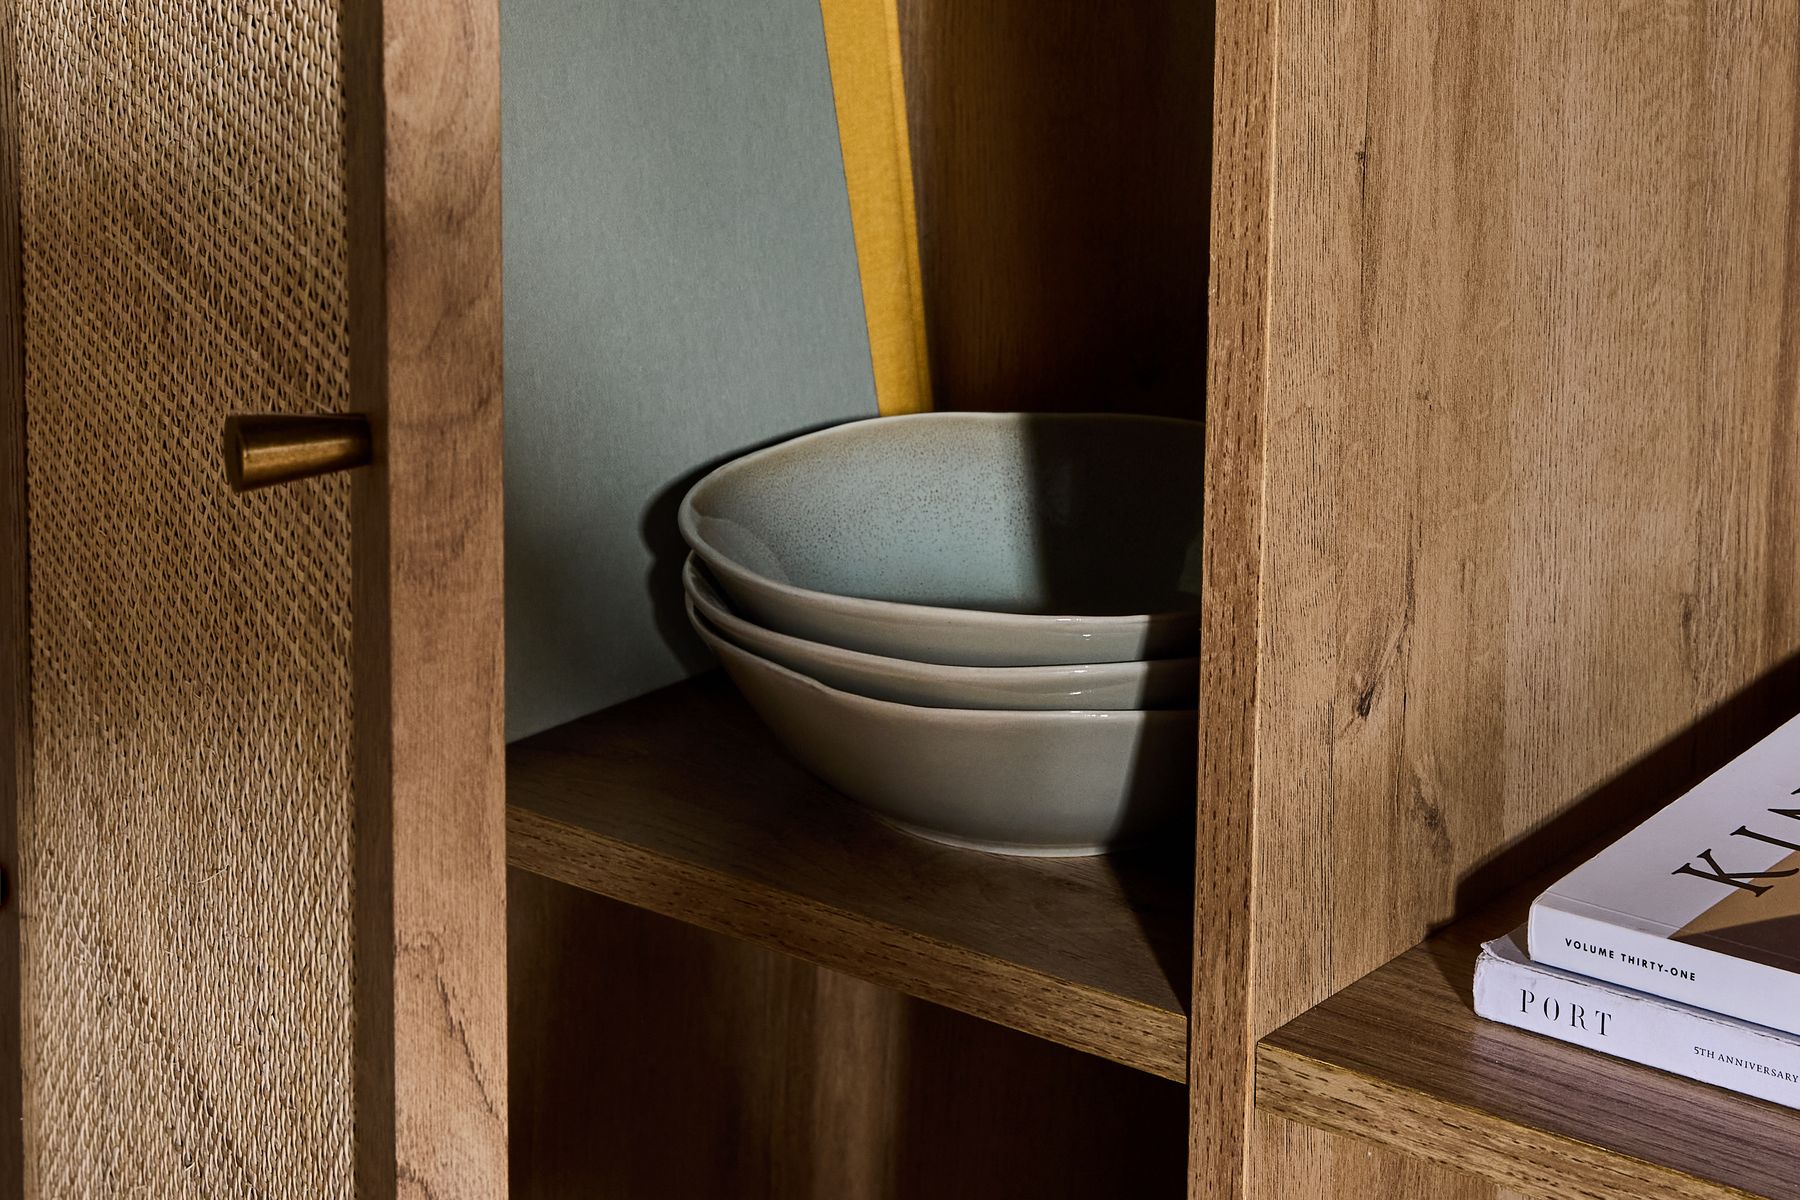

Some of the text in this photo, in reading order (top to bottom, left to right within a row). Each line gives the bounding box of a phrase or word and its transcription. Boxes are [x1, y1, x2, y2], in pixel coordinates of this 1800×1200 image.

[1671, 788, 1800, 897] KI
[1565, 938, 1696, 982] VOLUME THIRTY-ONE
[1520, 988, 1612, 1036] PORT
[1694, 1046, 1799, 1083] 5TH ANNIVERSARY
